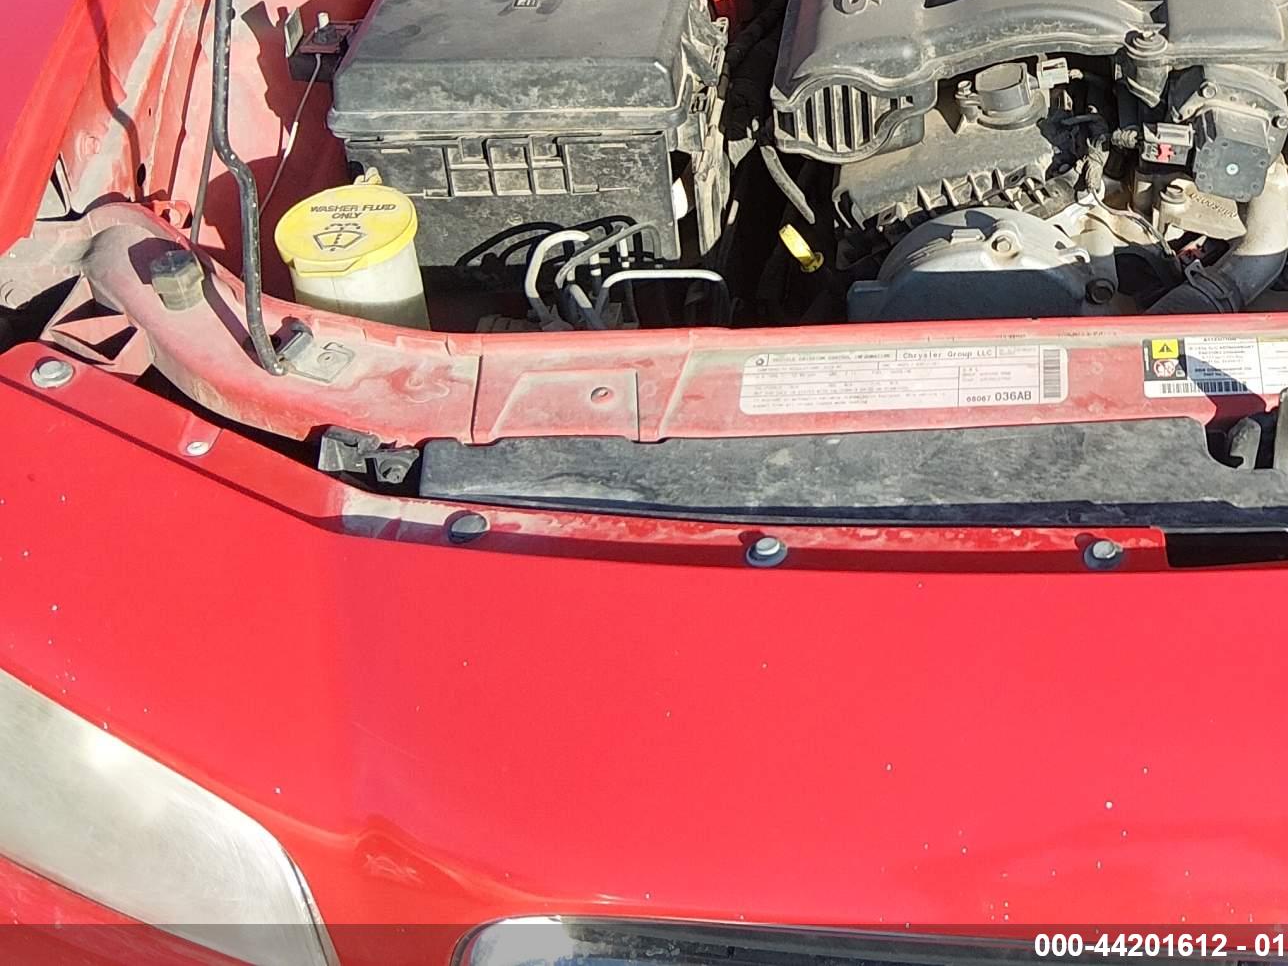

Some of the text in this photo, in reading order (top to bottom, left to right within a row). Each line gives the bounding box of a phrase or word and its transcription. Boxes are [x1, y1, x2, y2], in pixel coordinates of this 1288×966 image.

[332, 212, 362, 220] ONLY
[903, 350, 942, 360] Chrysler
[947, 349, 973, 360] Group
[976, 349, 993, 357] LLC
[994, 390, 1032, 402] 036AB
